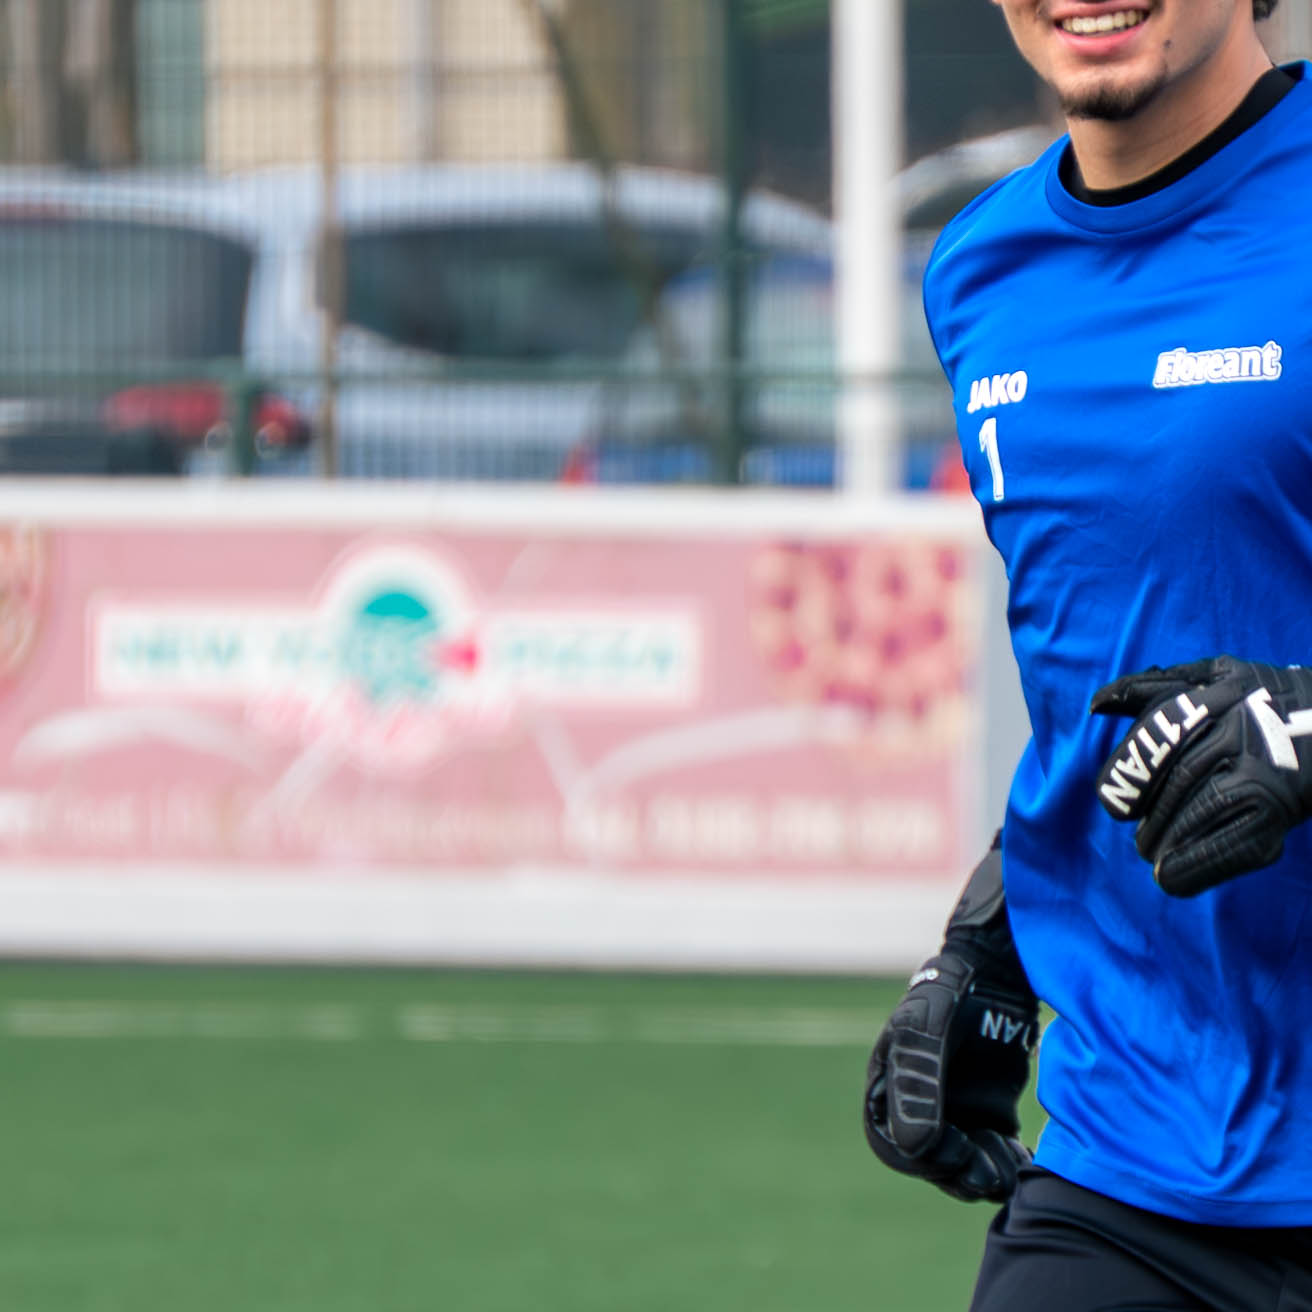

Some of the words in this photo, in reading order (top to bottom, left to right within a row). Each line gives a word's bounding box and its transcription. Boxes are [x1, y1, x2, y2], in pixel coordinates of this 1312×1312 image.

[1153, 340, 1282, 388] Floreant
[967, 370, 1028, 413] JAKO
[978, 417, 1004, 501] 1
